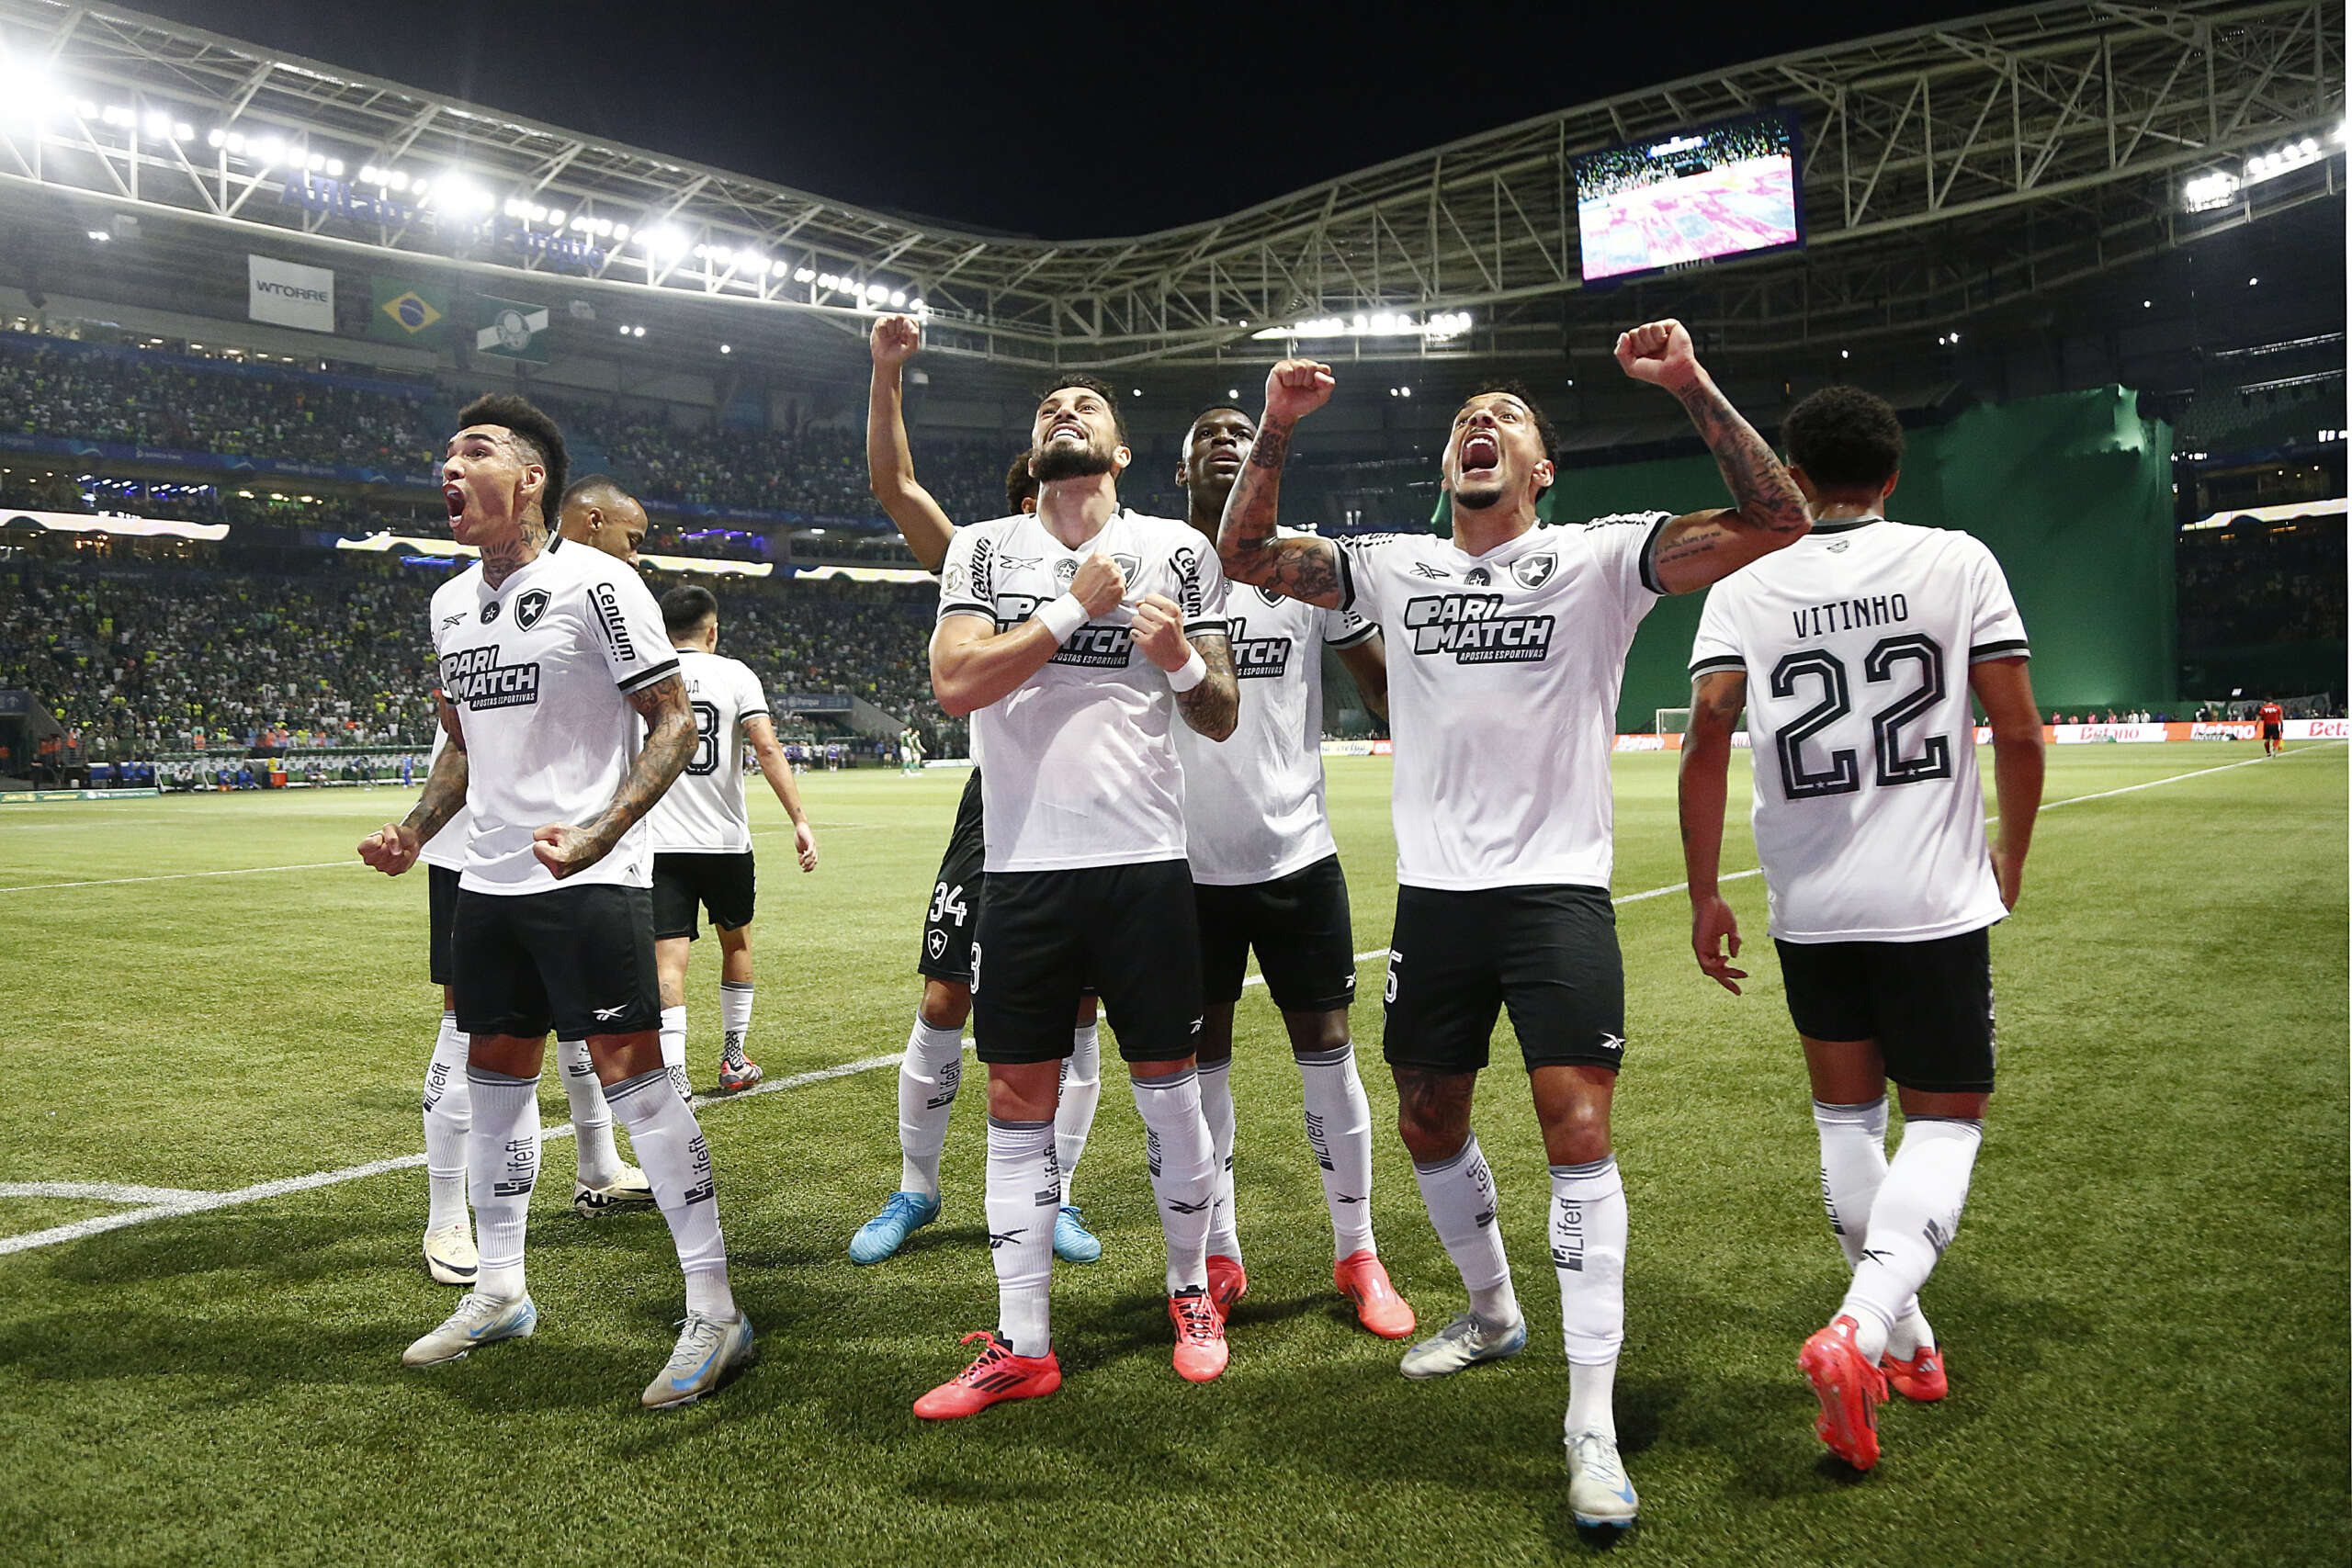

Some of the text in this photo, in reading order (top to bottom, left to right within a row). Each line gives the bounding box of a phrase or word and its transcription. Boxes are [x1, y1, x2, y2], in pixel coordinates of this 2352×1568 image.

[256, 280, 329, 303] WTORRE
[1175, 547, 1202, 618] Centrum
[596, 581, 637, 662] Centrum
[1407, 596, 1500, 626] PARI
[1792, 592, 1909, 638] VITINHO
[1416, 619, 1552, 651] MATCH
[441, 647, 498, 680] PARI
[1082, 654, 1127, 665] ESPORTIVAS
[1243, 666, 1283, 676] ESPORTIVAS
[1460, 649, 1544, 661] APOSTAS ESPORTIVAS
[448, 666, 537, 704] MATCH
[471, 692, 536, 708] APOSTAS ESPORTIVAS
[1770, 632, 1952, 800] 22
[2191, 723, 2257, 740] Betano
[929, 880, 967, 927] 34
[505, 1135, 534, 1182] Lifefit
[688, 1134, 713, 1186] Lifefit
